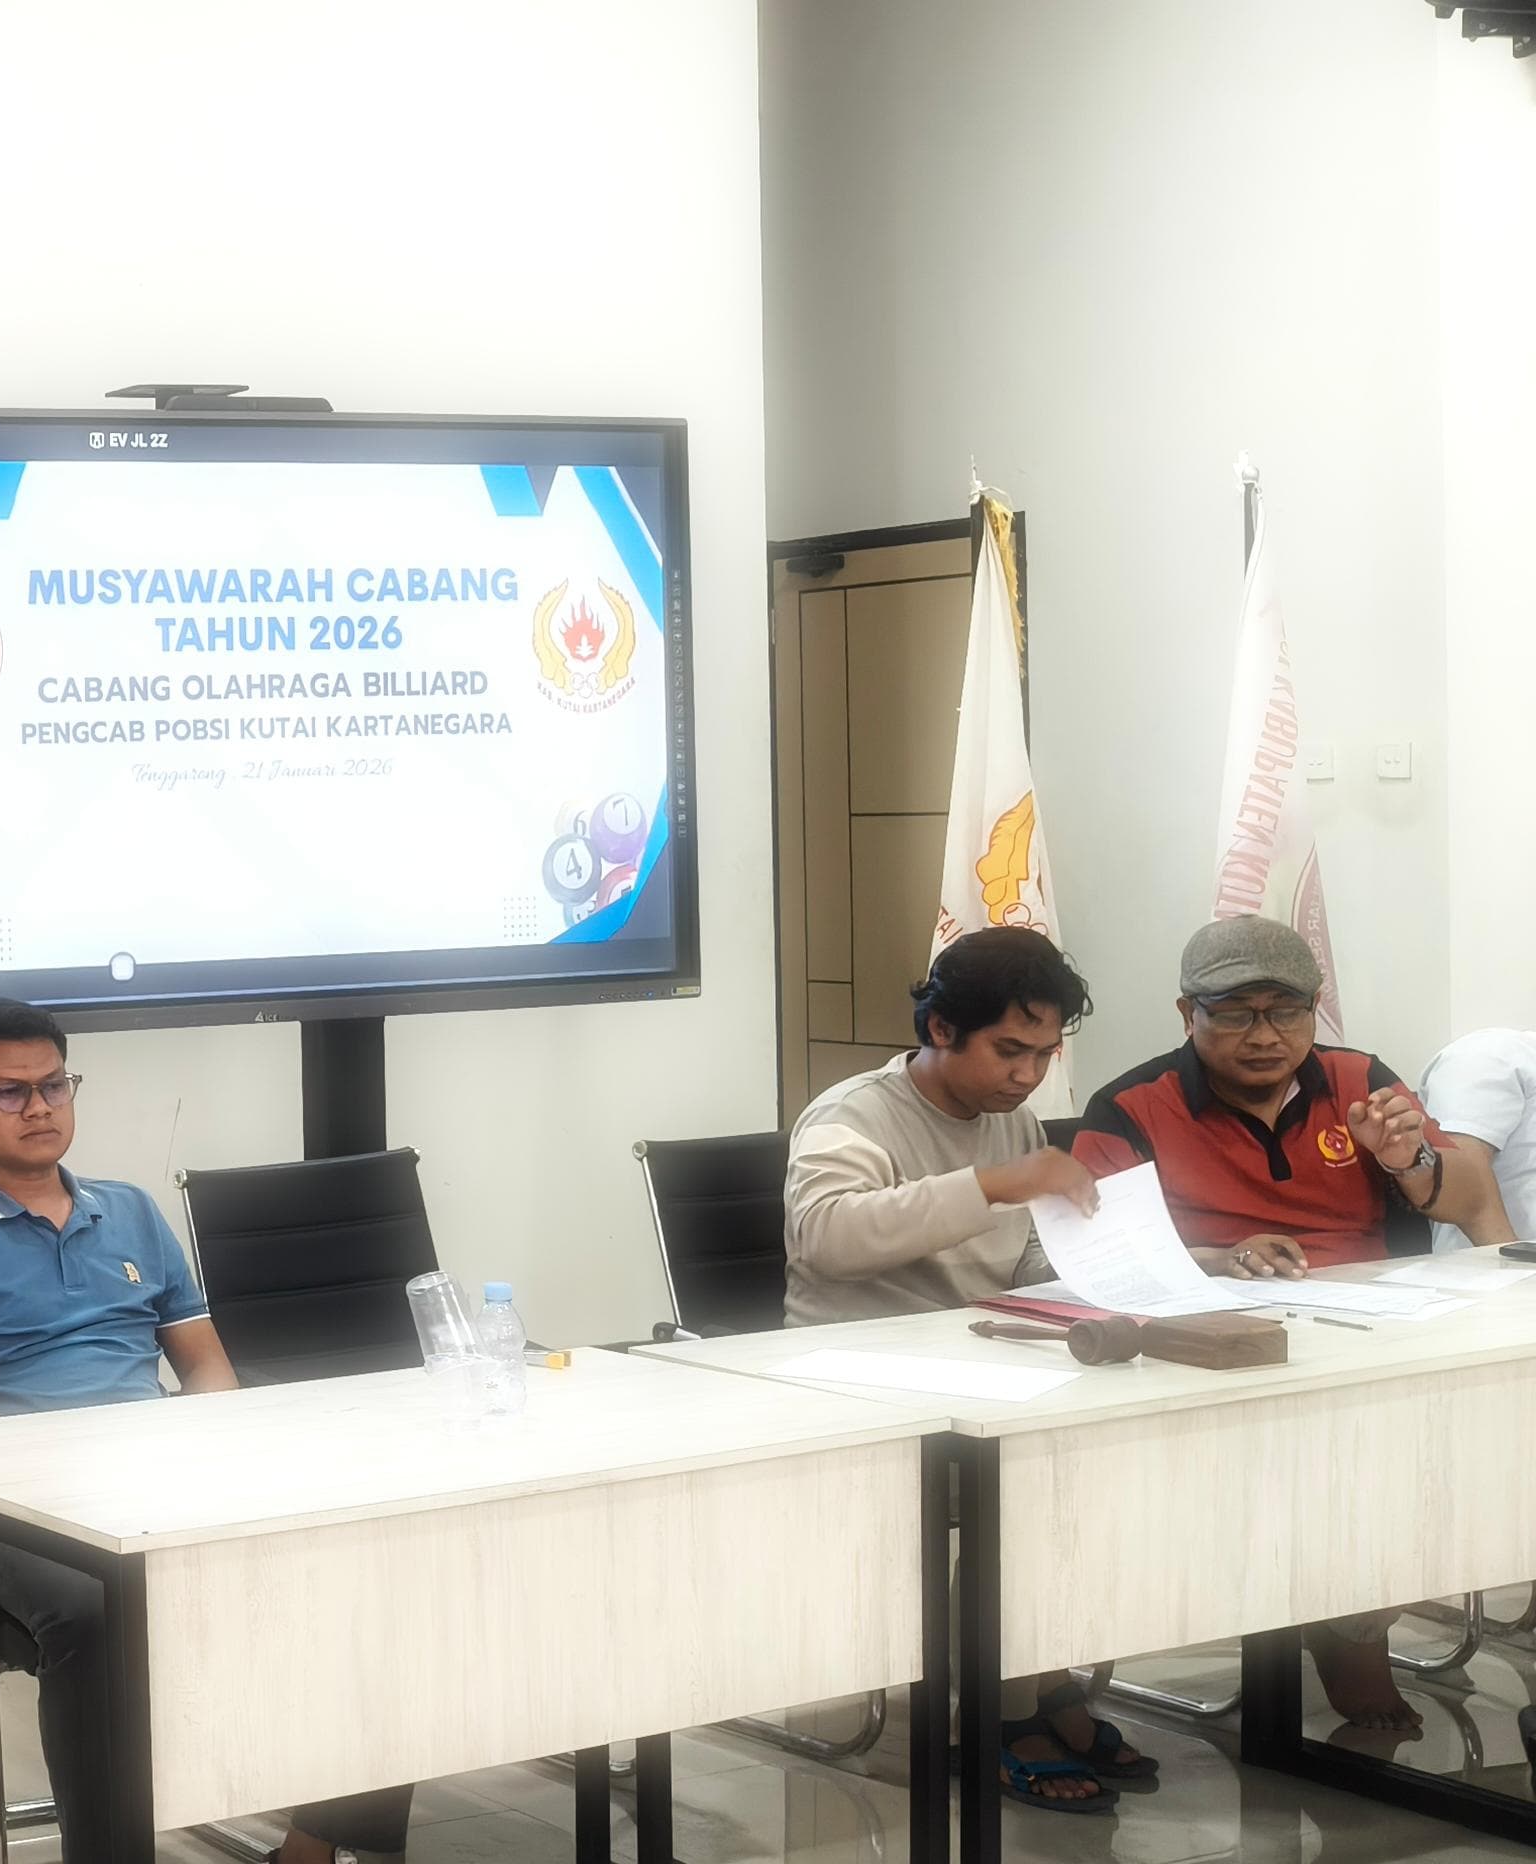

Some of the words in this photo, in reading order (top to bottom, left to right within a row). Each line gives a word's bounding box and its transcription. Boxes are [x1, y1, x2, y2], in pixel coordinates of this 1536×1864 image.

[109, 432, 128, 447] EV
[130, 432, 148, 448] JL
[28, 568, 333, 604] MUSYAWARAH
[347, 568, 518, 602] CABANG
[155, 616, 296, 652] TAHUN
[309, 615, 403, 650] 2026
[38, 674, 171, 703] CABANG
[182, 672, 352, 700] OLAHRAGA
[363, 670, 488, 697] BILLIARD
[21, 720, 146, 744] PENGCAB
[155, 718, 230, 742] POBSI
[240, 716, 316, 740] KUTAI
[326, 713, 513, 738] KARTANEGARA
[241, 761, 264, 779] 21
[268, 760, 336, 781] Januari
[343, 758, 394, 776] 2026
[613, 798, 629, 826] 7
[566, 847, 582, 879] 4
